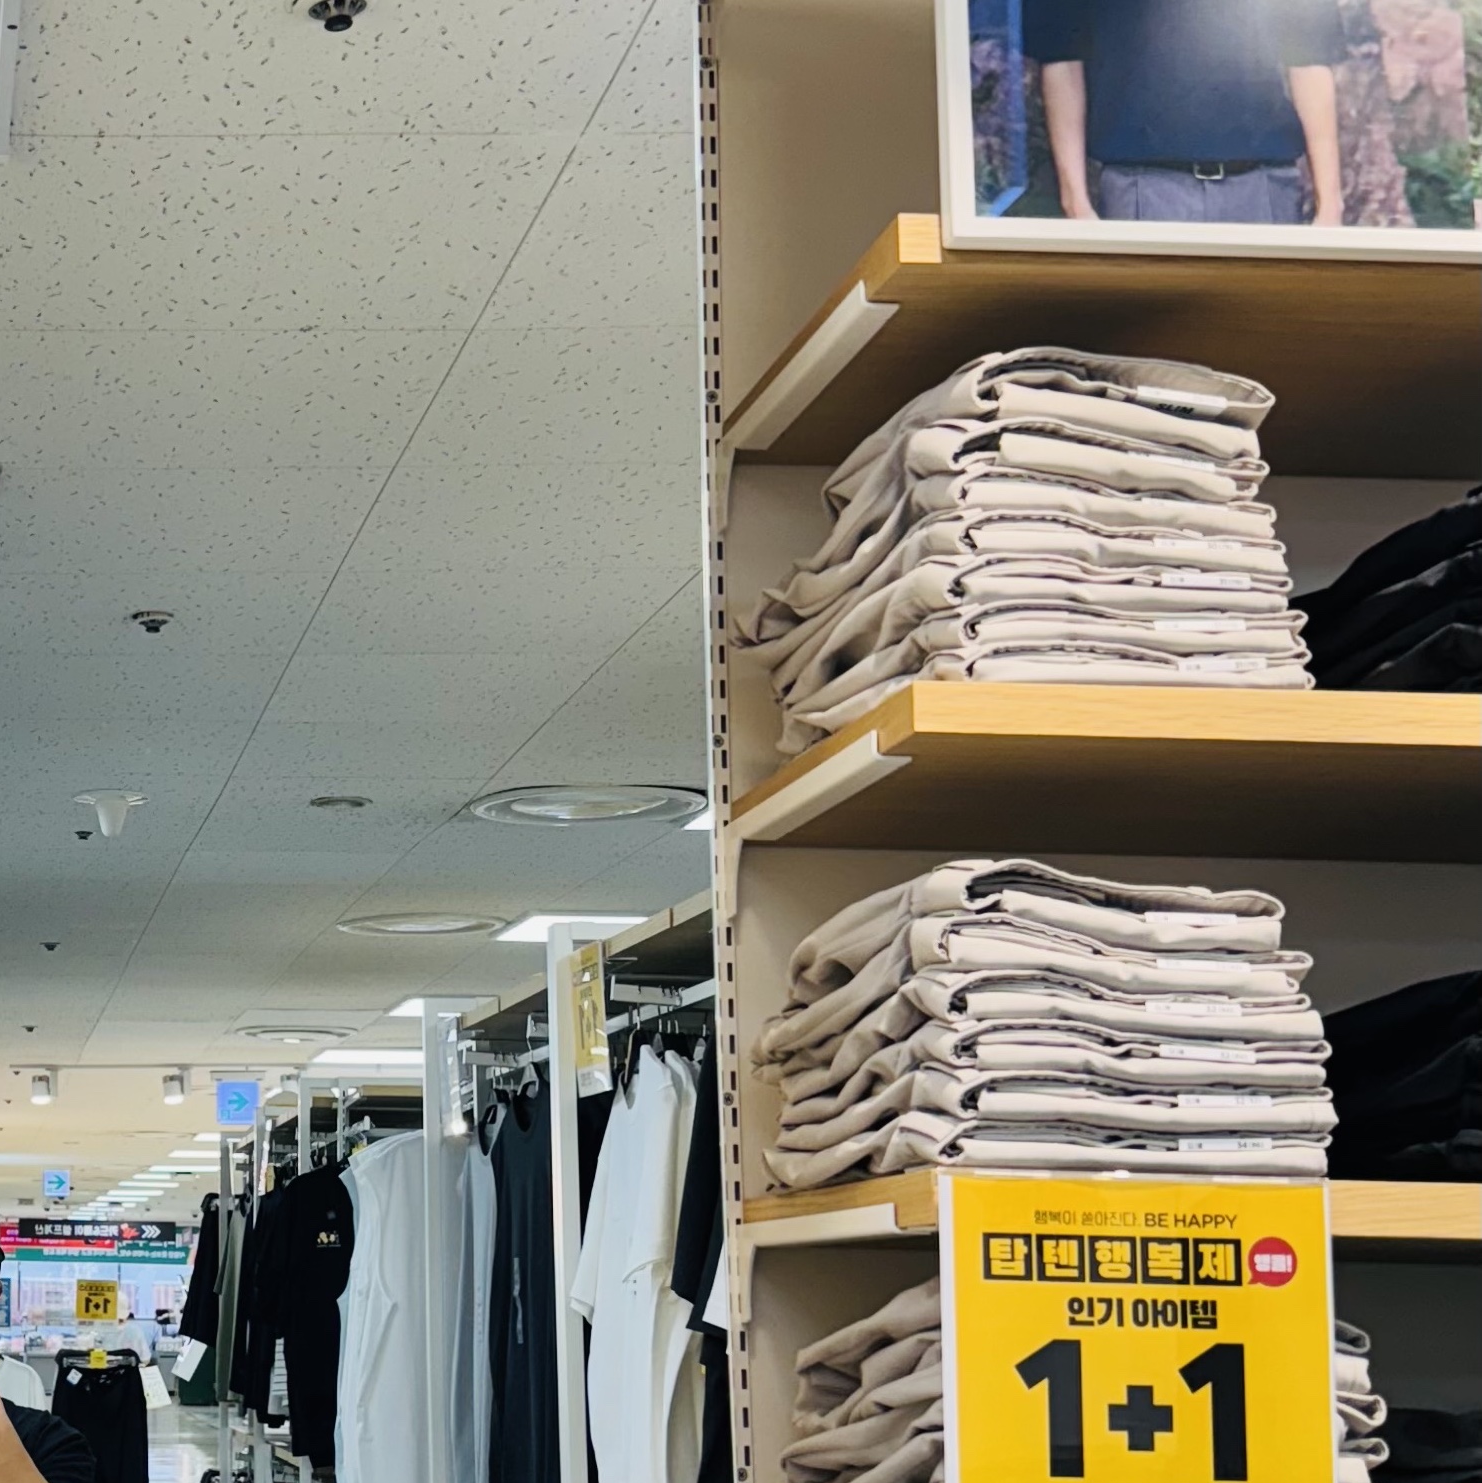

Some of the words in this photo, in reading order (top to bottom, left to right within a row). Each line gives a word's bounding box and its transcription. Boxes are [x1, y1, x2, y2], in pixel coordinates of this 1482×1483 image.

[1144, 1213, 1170, 1228] BE
[1173, 1214, 1238, 1230] HAPPY
[1068, 1297, 1124, 1328] 인기
[1132, 1299, 1218, 1330] 아이템
[1014, 1339, 1248, 1482] 1+1
